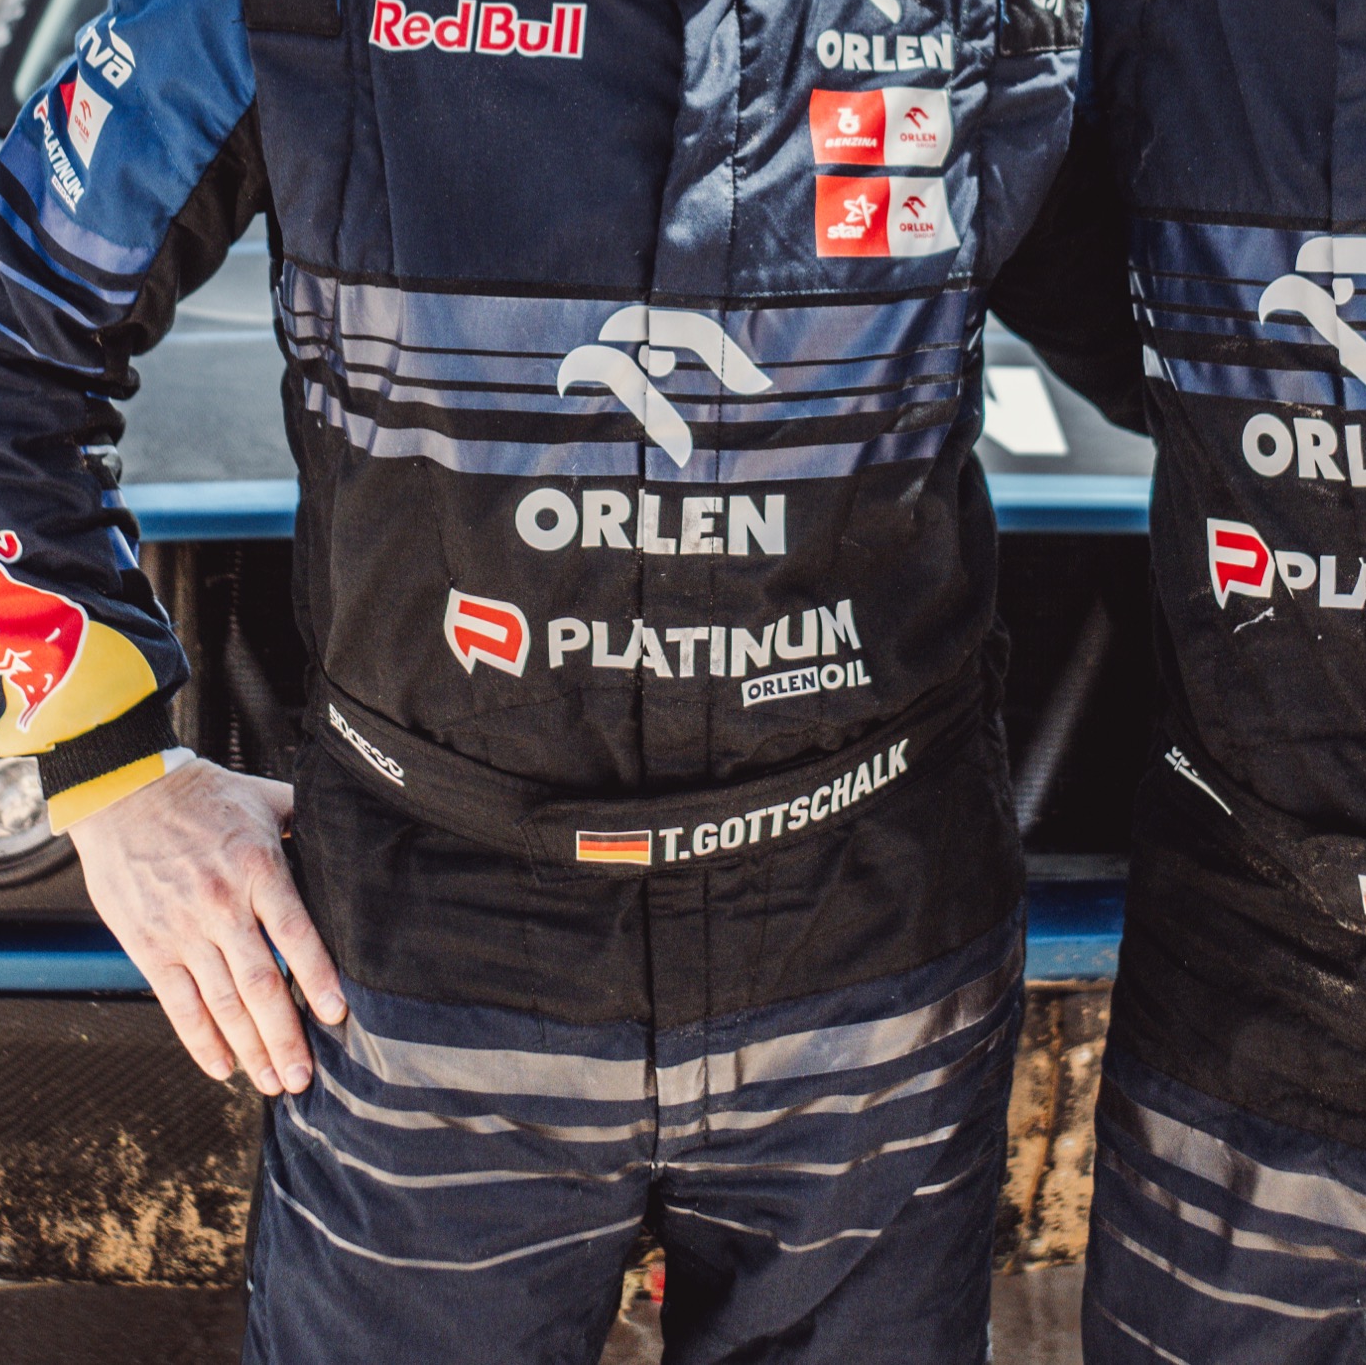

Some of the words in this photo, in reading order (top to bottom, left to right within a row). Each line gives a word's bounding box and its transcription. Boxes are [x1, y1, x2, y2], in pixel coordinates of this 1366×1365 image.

[476, 1, 586, 59] Bull
[817, 30, 954, 71] ORLEN
[824, 136, 877, 148] BENZINA
[900, 133, 936, 142] ORLEN
[43, 121, 84, 203] PLATINUM
[827, 222, 865, 239] star
[899, 223, 934, 232] ORLEN
[515, 488, 786, 555] ORLEN
[548, 599, 861, 678] PLATINUM
[746, 672, 817, 701] ORLEN
[818, 659, 871, 691] OIL
[659, 738, 909, 861] T.GOTTSCHALK
